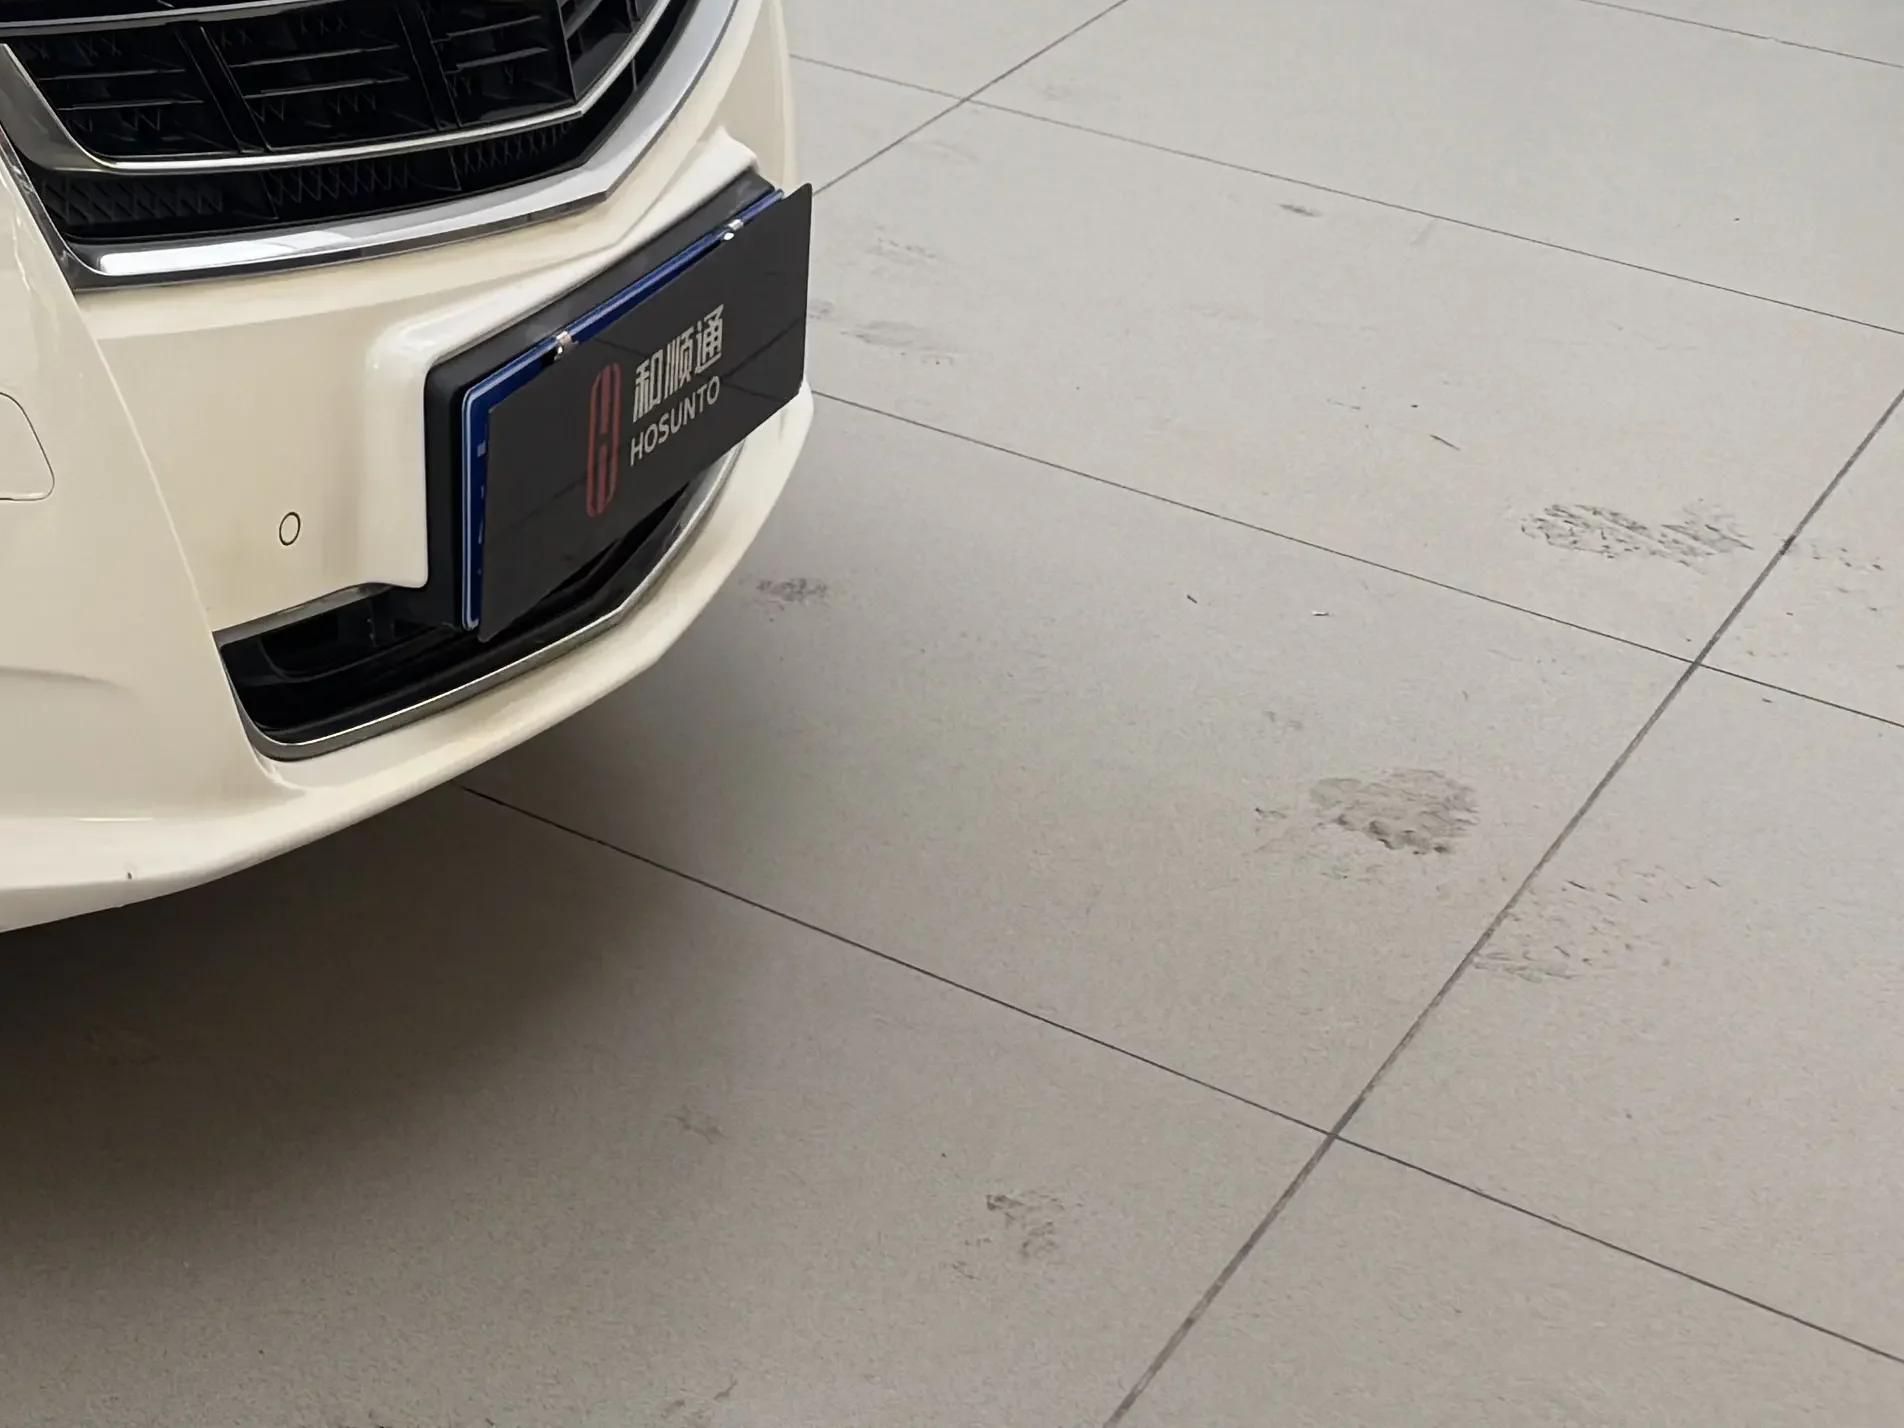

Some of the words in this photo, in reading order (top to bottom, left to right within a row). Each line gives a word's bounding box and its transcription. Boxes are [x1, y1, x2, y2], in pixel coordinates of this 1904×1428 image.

[632, 303, 725, 423] 和顺通
[629, 374, 720, 467] HOSUNTO
